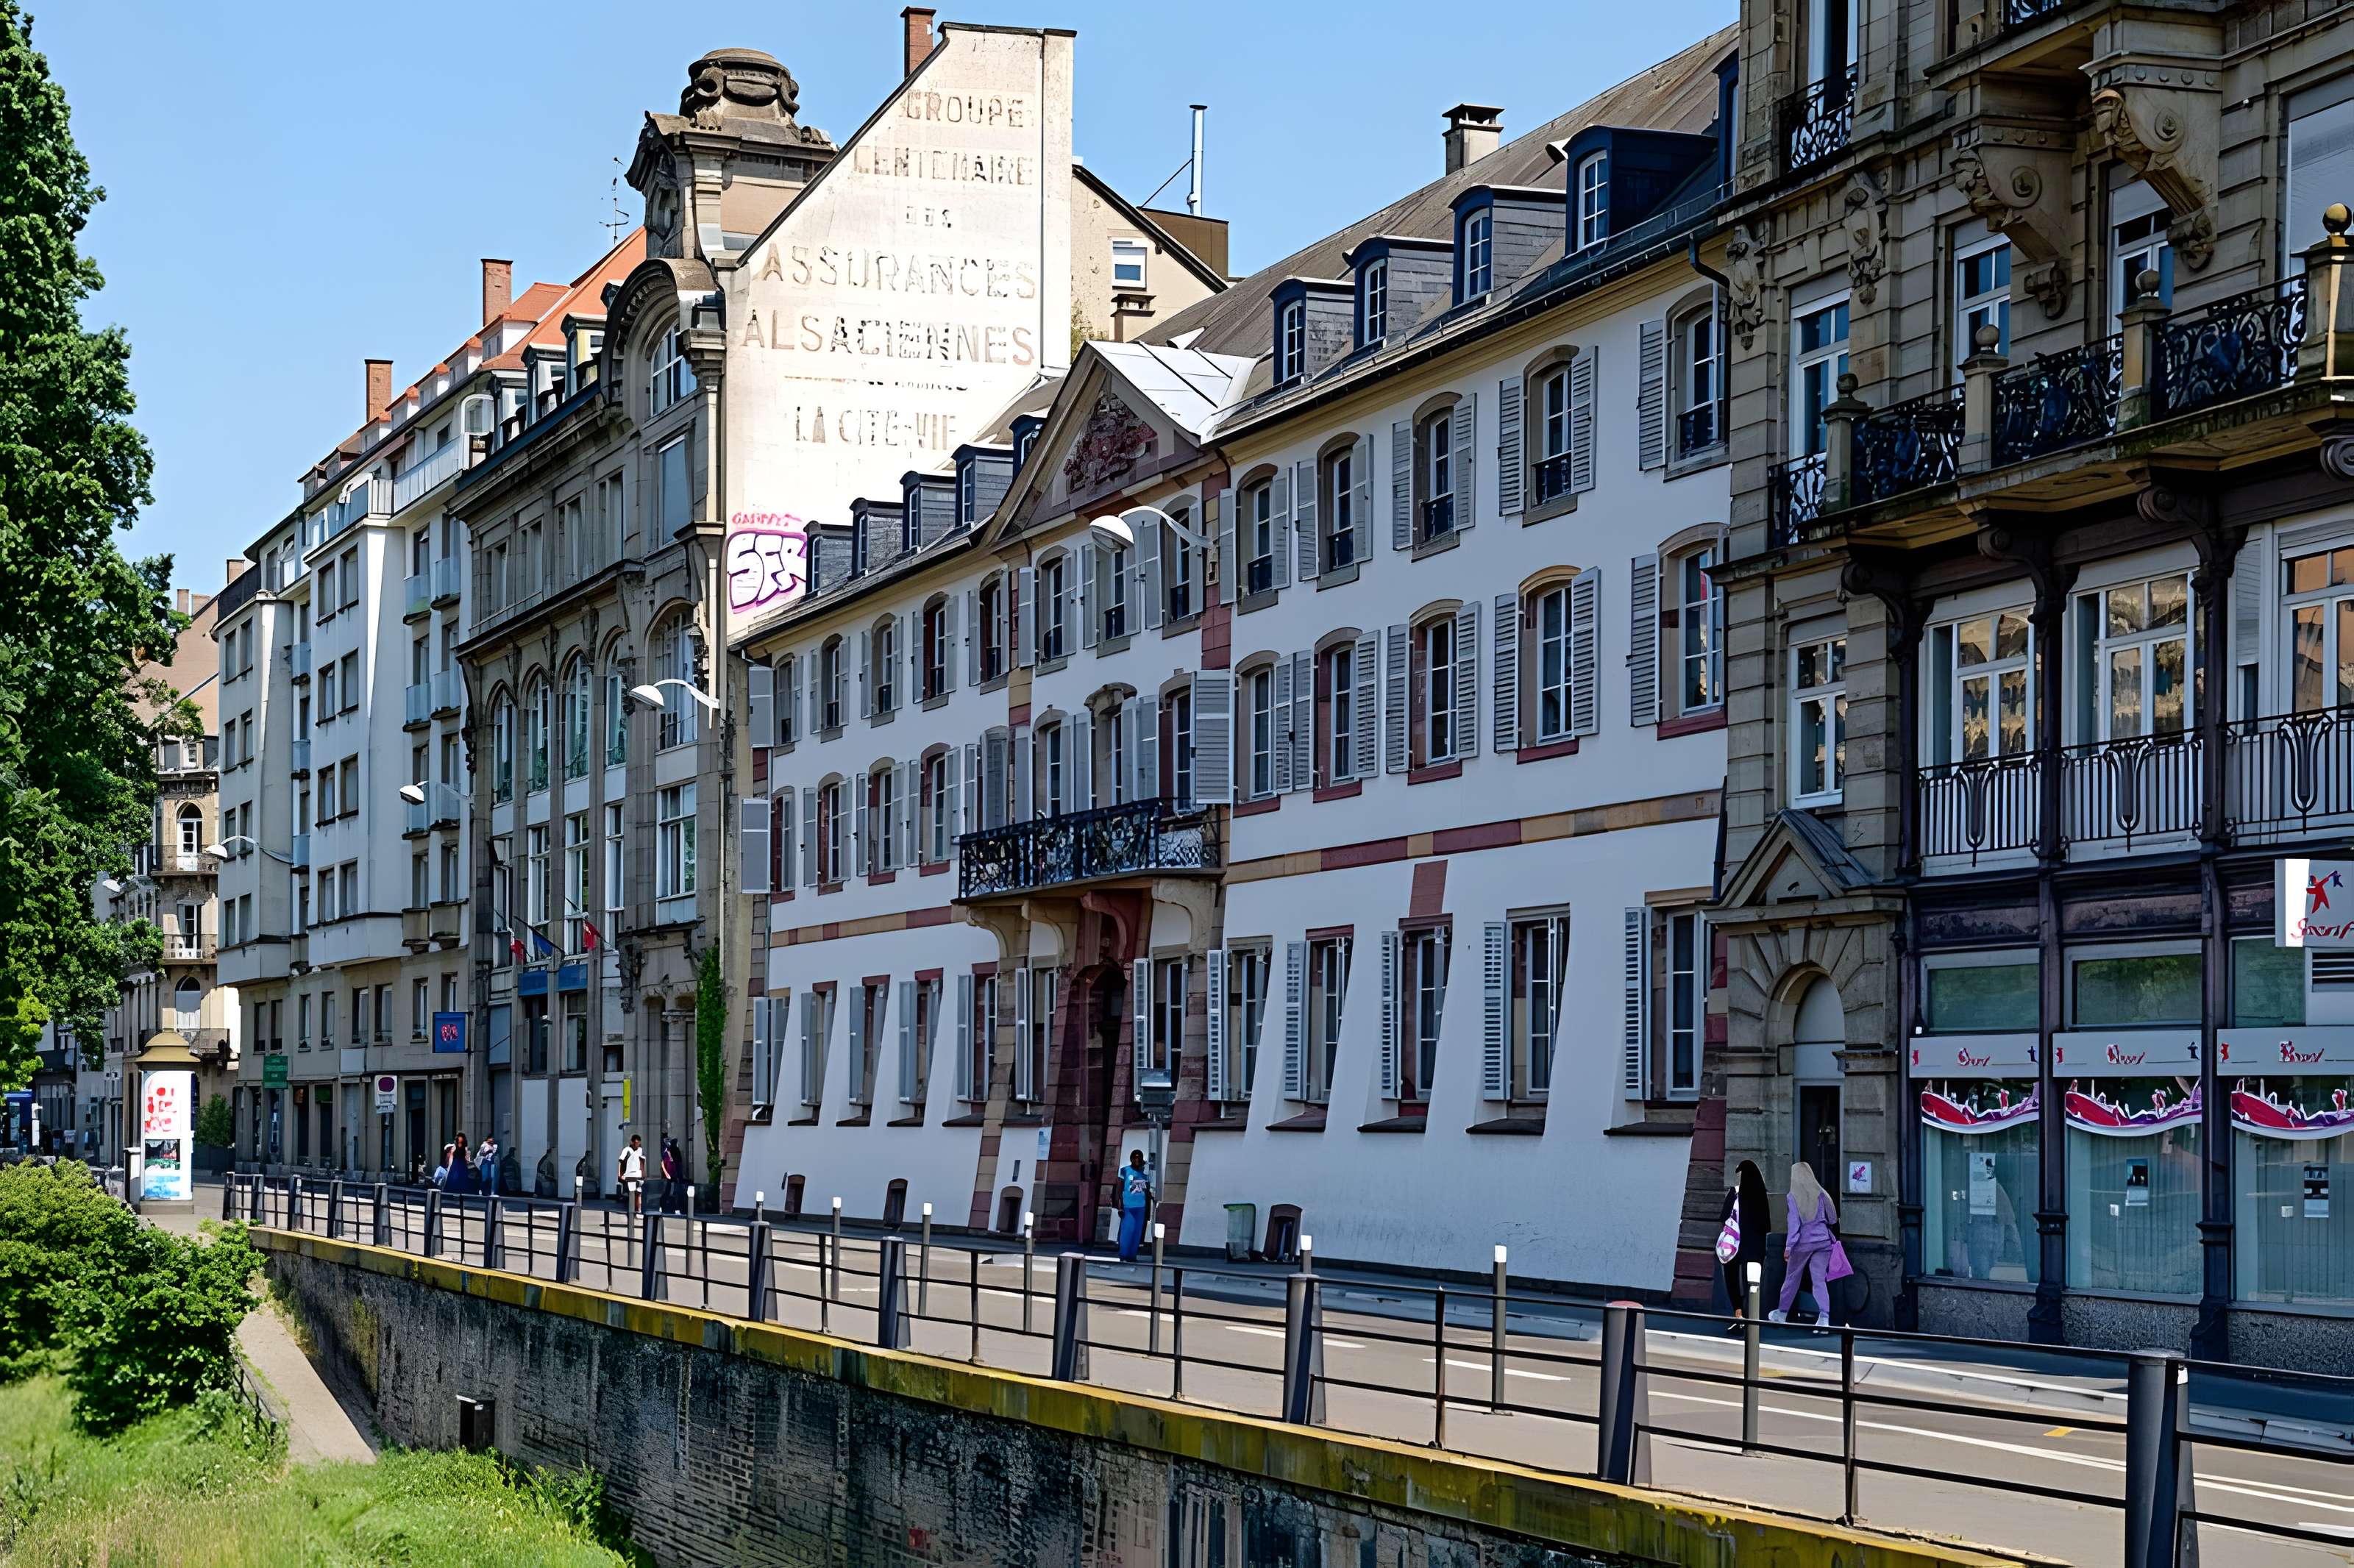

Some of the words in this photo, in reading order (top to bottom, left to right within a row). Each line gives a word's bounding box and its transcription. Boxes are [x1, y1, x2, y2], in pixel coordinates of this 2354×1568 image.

[905, 90, 1025, 128] GROUPE
[754, 241, 1036, 299] ASSURANCES
[740, 308, 1036, 366] ALSACIENNES
